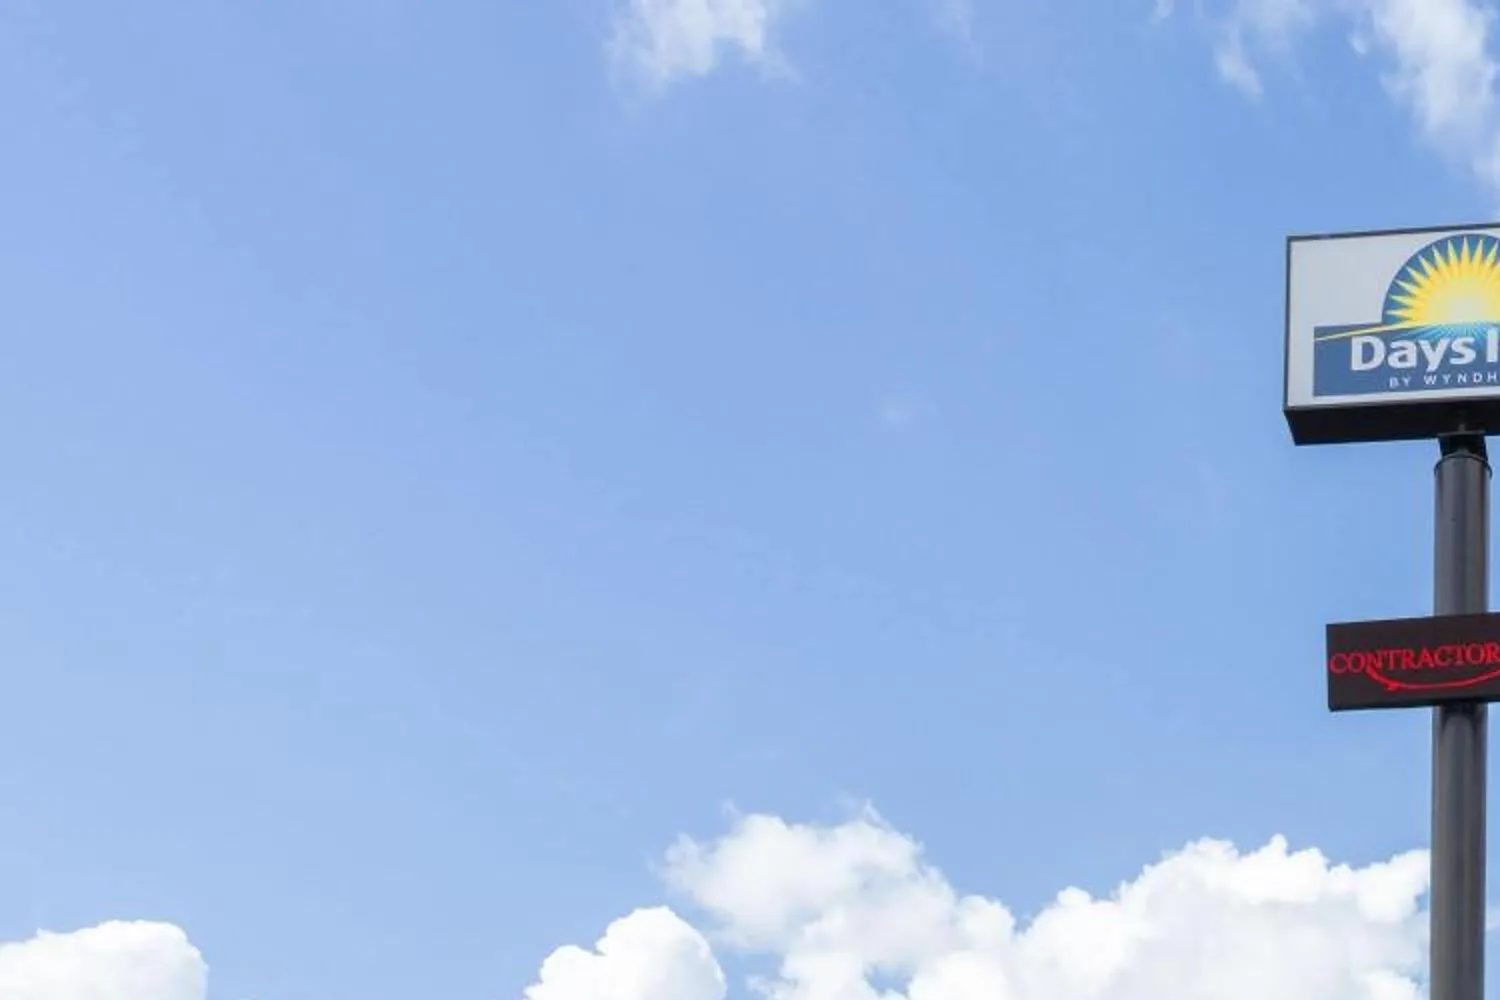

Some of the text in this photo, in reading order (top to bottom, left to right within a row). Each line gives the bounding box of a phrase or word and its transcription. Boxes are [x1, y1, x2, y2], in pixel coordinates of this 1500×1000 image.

[1351, 335, 1476, 371] Days
[1390, 376, 1412, 388] BY
[1330, 642, 1500, 673] CONTRACTOR
